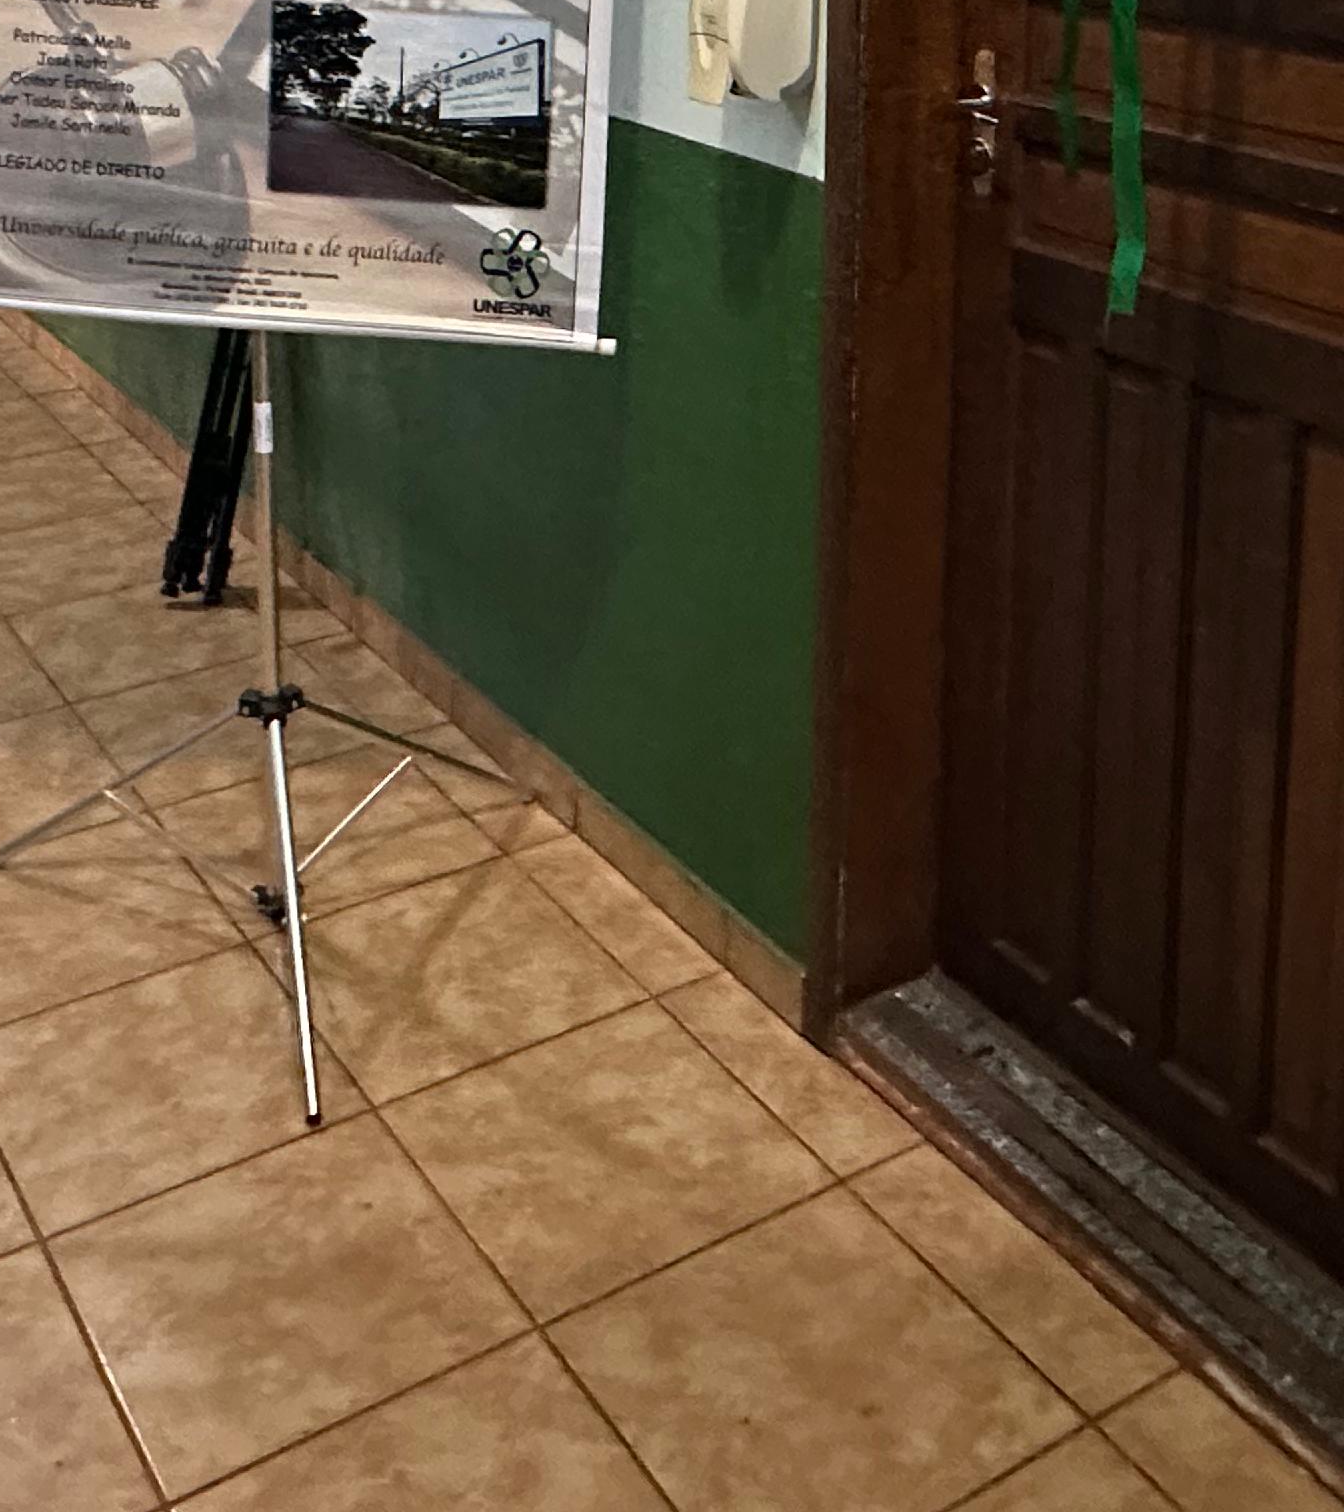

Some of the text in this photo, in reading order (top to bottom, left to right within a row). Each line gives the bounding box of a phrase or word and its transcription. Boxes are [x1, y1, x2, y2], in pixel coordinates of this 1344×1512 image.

[37, 51, 71, 67] José
[124, 101, 181, 118] Miranda
[72, 161, 92, 175] DE
[96, 162, 165, 179] DIREITO
[212, 235, 297, 258] gratuita
[304, 245, 313, 256] e
[320, 237, 342, 257] de
[348, 239, 446, 267] qualidade
[472, 298, 552, 319] UNESPAR
